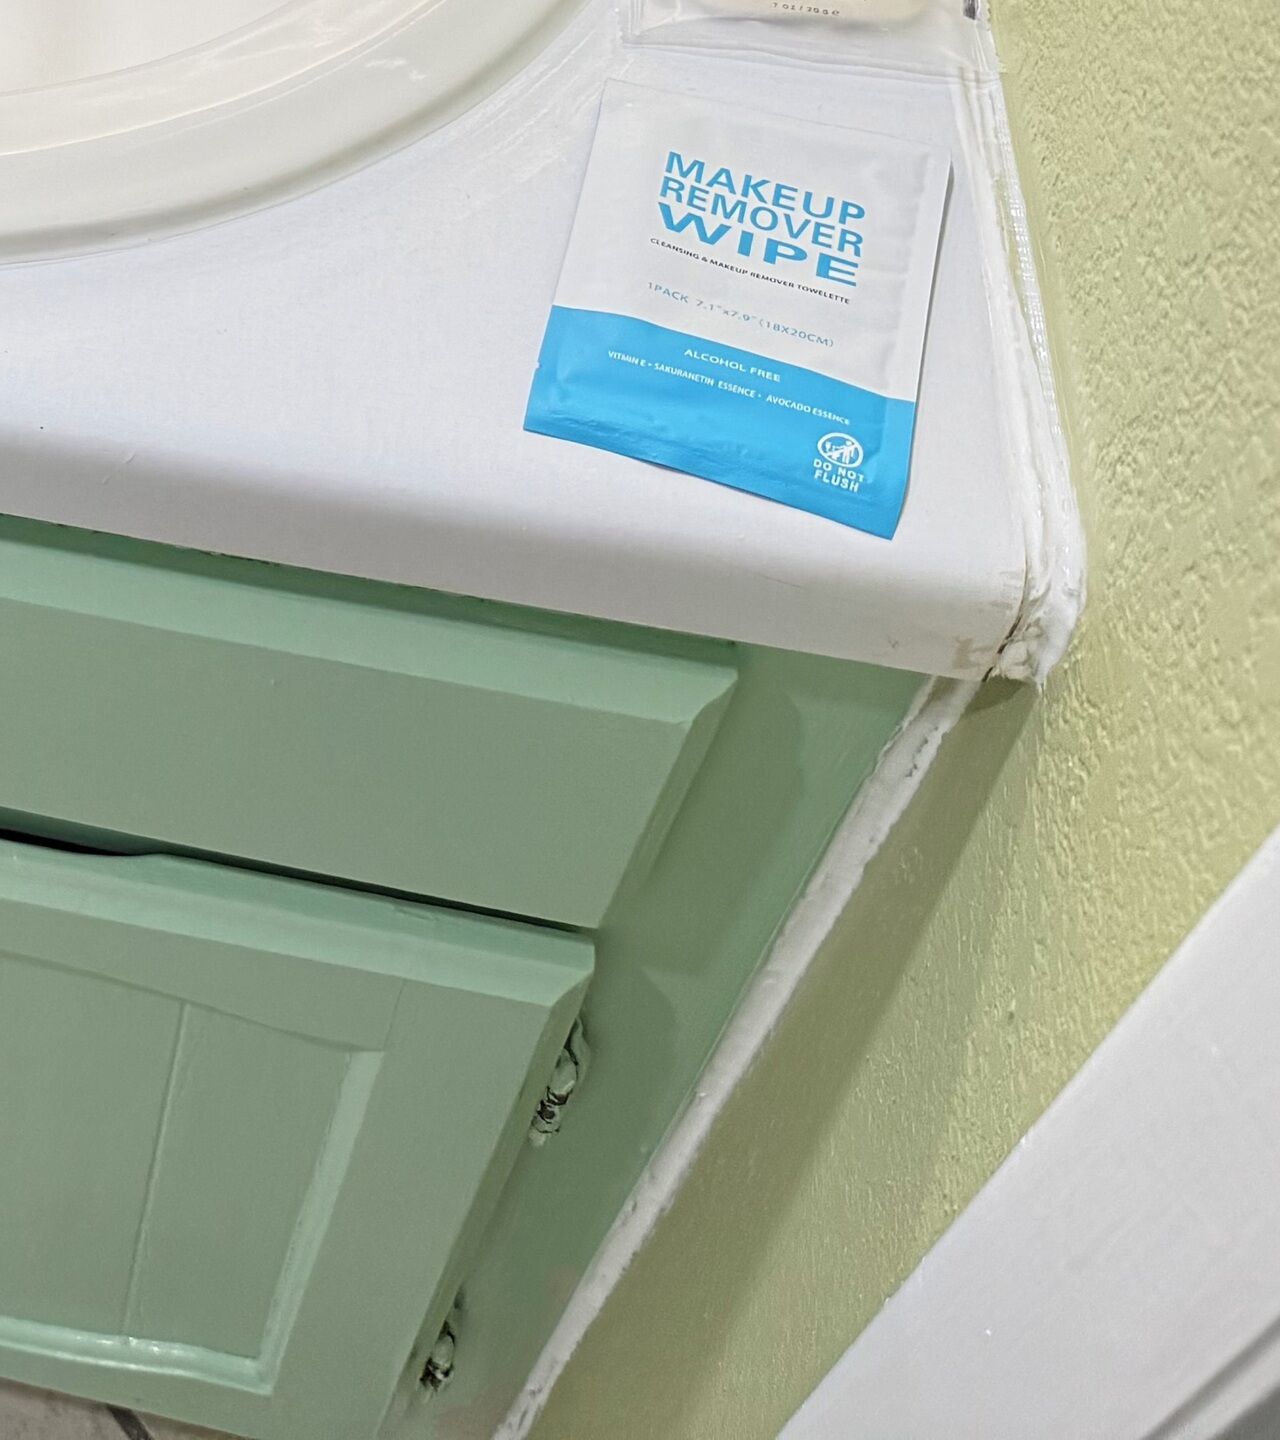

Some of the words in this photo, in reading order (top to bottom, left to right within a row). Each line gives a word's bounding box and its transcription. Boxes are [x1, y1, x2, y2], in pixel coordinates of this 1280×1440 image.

[659, 175, 864, 258] REMOVER
[665, 151, 866, 226] MAKEUP
[650, 237, 700, 260] CLEANSING
[709, 258, 749, 275] MAKEUP
[749, 271, 794, 289] REMOVER
[797, 284, 851, 305] TOWELETTE
[658, 201, 859, 287] WIPE
[654, 362, 714, 387] SAKURANETIN
[718, 380, 756, 398] ESSENCE
[766, 394, 811, 414] AVOCADO
[812, 407, 850, 426] ESSENCE
[684, 348, 746, 373] ALCOHOL
[750, 366, 781, 383] FREE
[813, 458, 832, 472] DO
[837, 467, 865, 483] NOT
[814, 469, 860, 493] FLUSH
